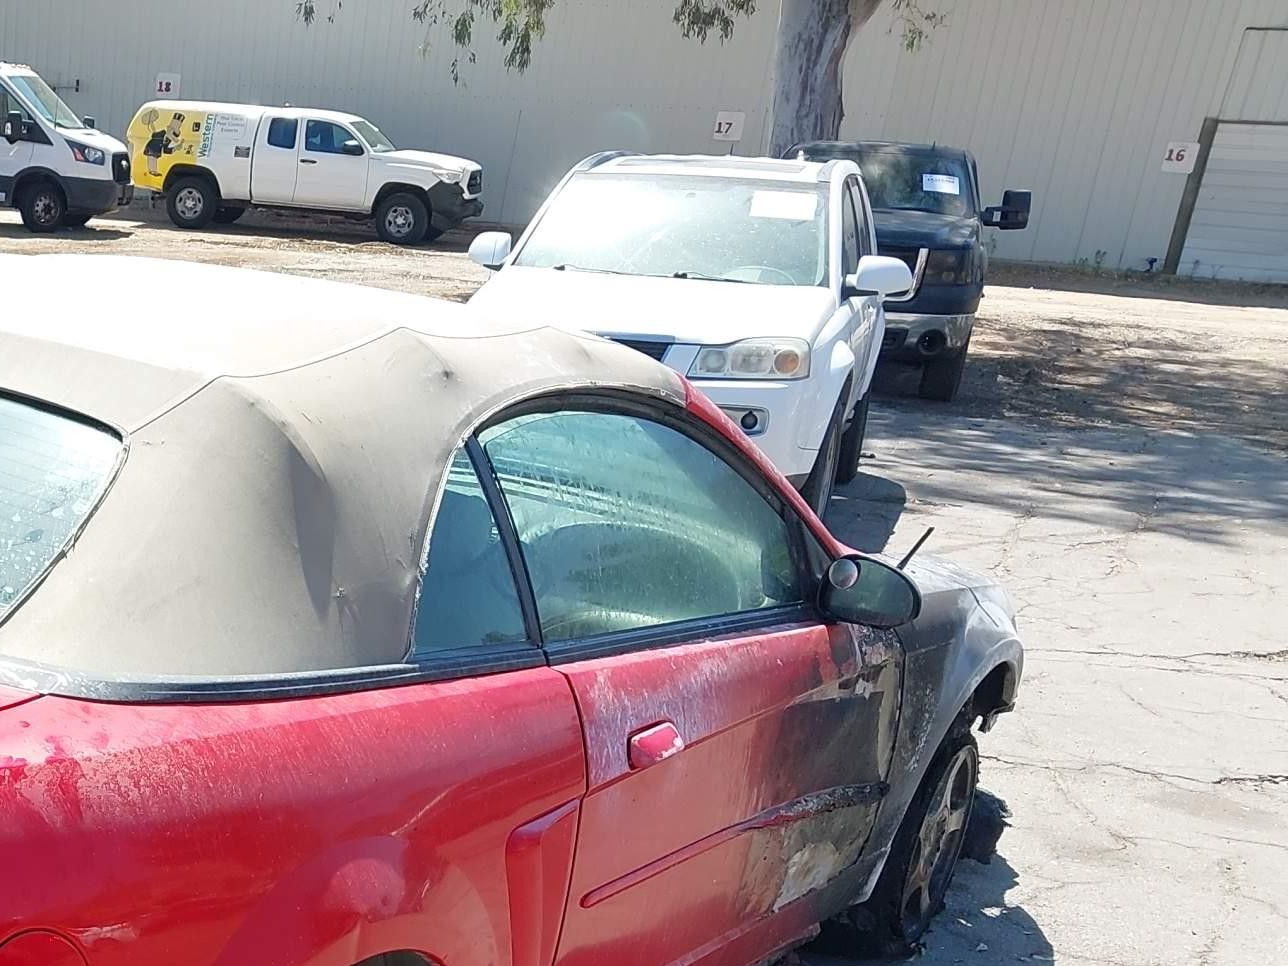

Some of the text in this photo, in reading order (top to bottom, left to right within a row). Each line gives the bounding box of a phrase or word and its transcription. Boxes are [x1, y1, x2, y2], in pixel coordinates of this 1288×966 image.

[157, 81, 172, 93] 18
[714, 121, 733, 134] 17
[197, 113, 214, 158] Western
[1164, 148, 1186, 162] 16
